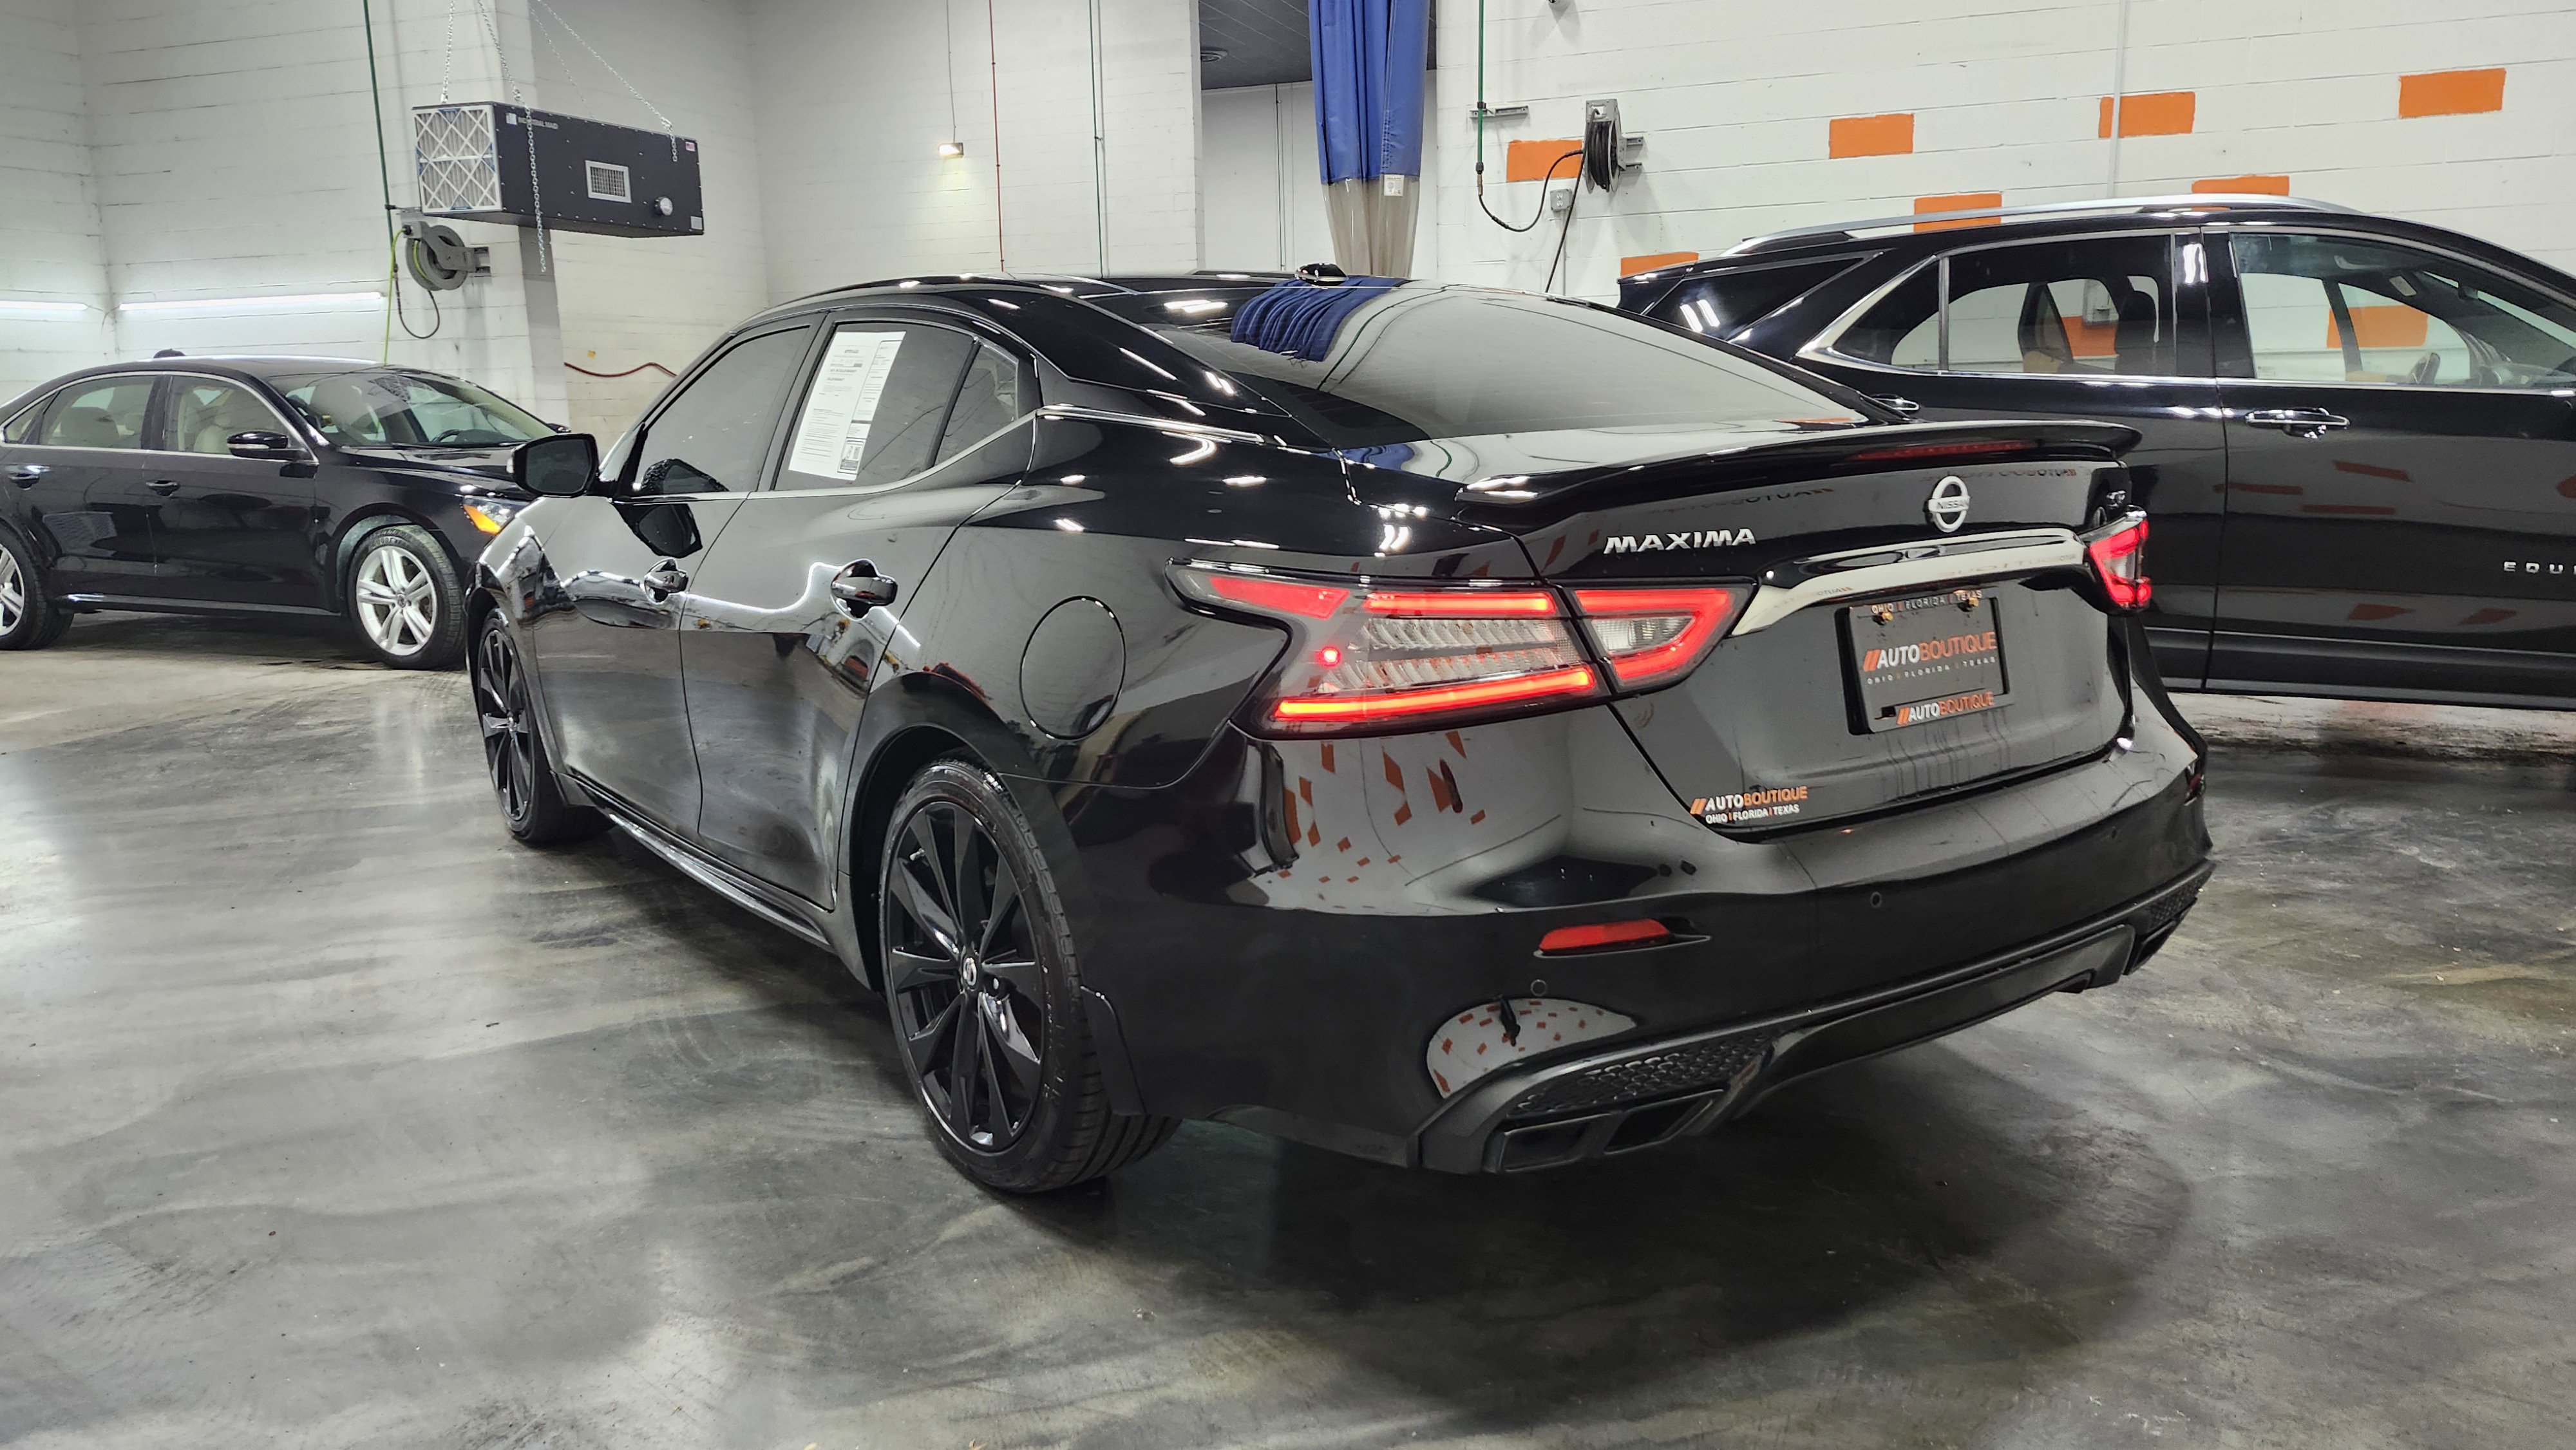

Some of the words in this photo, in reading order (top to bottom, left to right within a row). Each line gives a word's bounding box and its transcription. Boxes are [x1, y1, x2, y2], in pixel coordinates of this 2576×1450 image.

[1603, 528, 1756, 554] MAXIMA
[1871, 603, 1894, 614] OHIO
[1905, 596, 1946, 609] FLORIDA
[1877, 631, 1997, 669] AUTOBOUTIQUE
[1908, 691, 1994, 722] AUTOBOUTIQUE
[1705, 786, 1808, 812] AUTOBOUTIQUE
[1705, 813, 1728, 824] OHIO
[1732, 809, 1769, 821] FLORIDA
[1774, 804, 1801, 816] TEXAS
